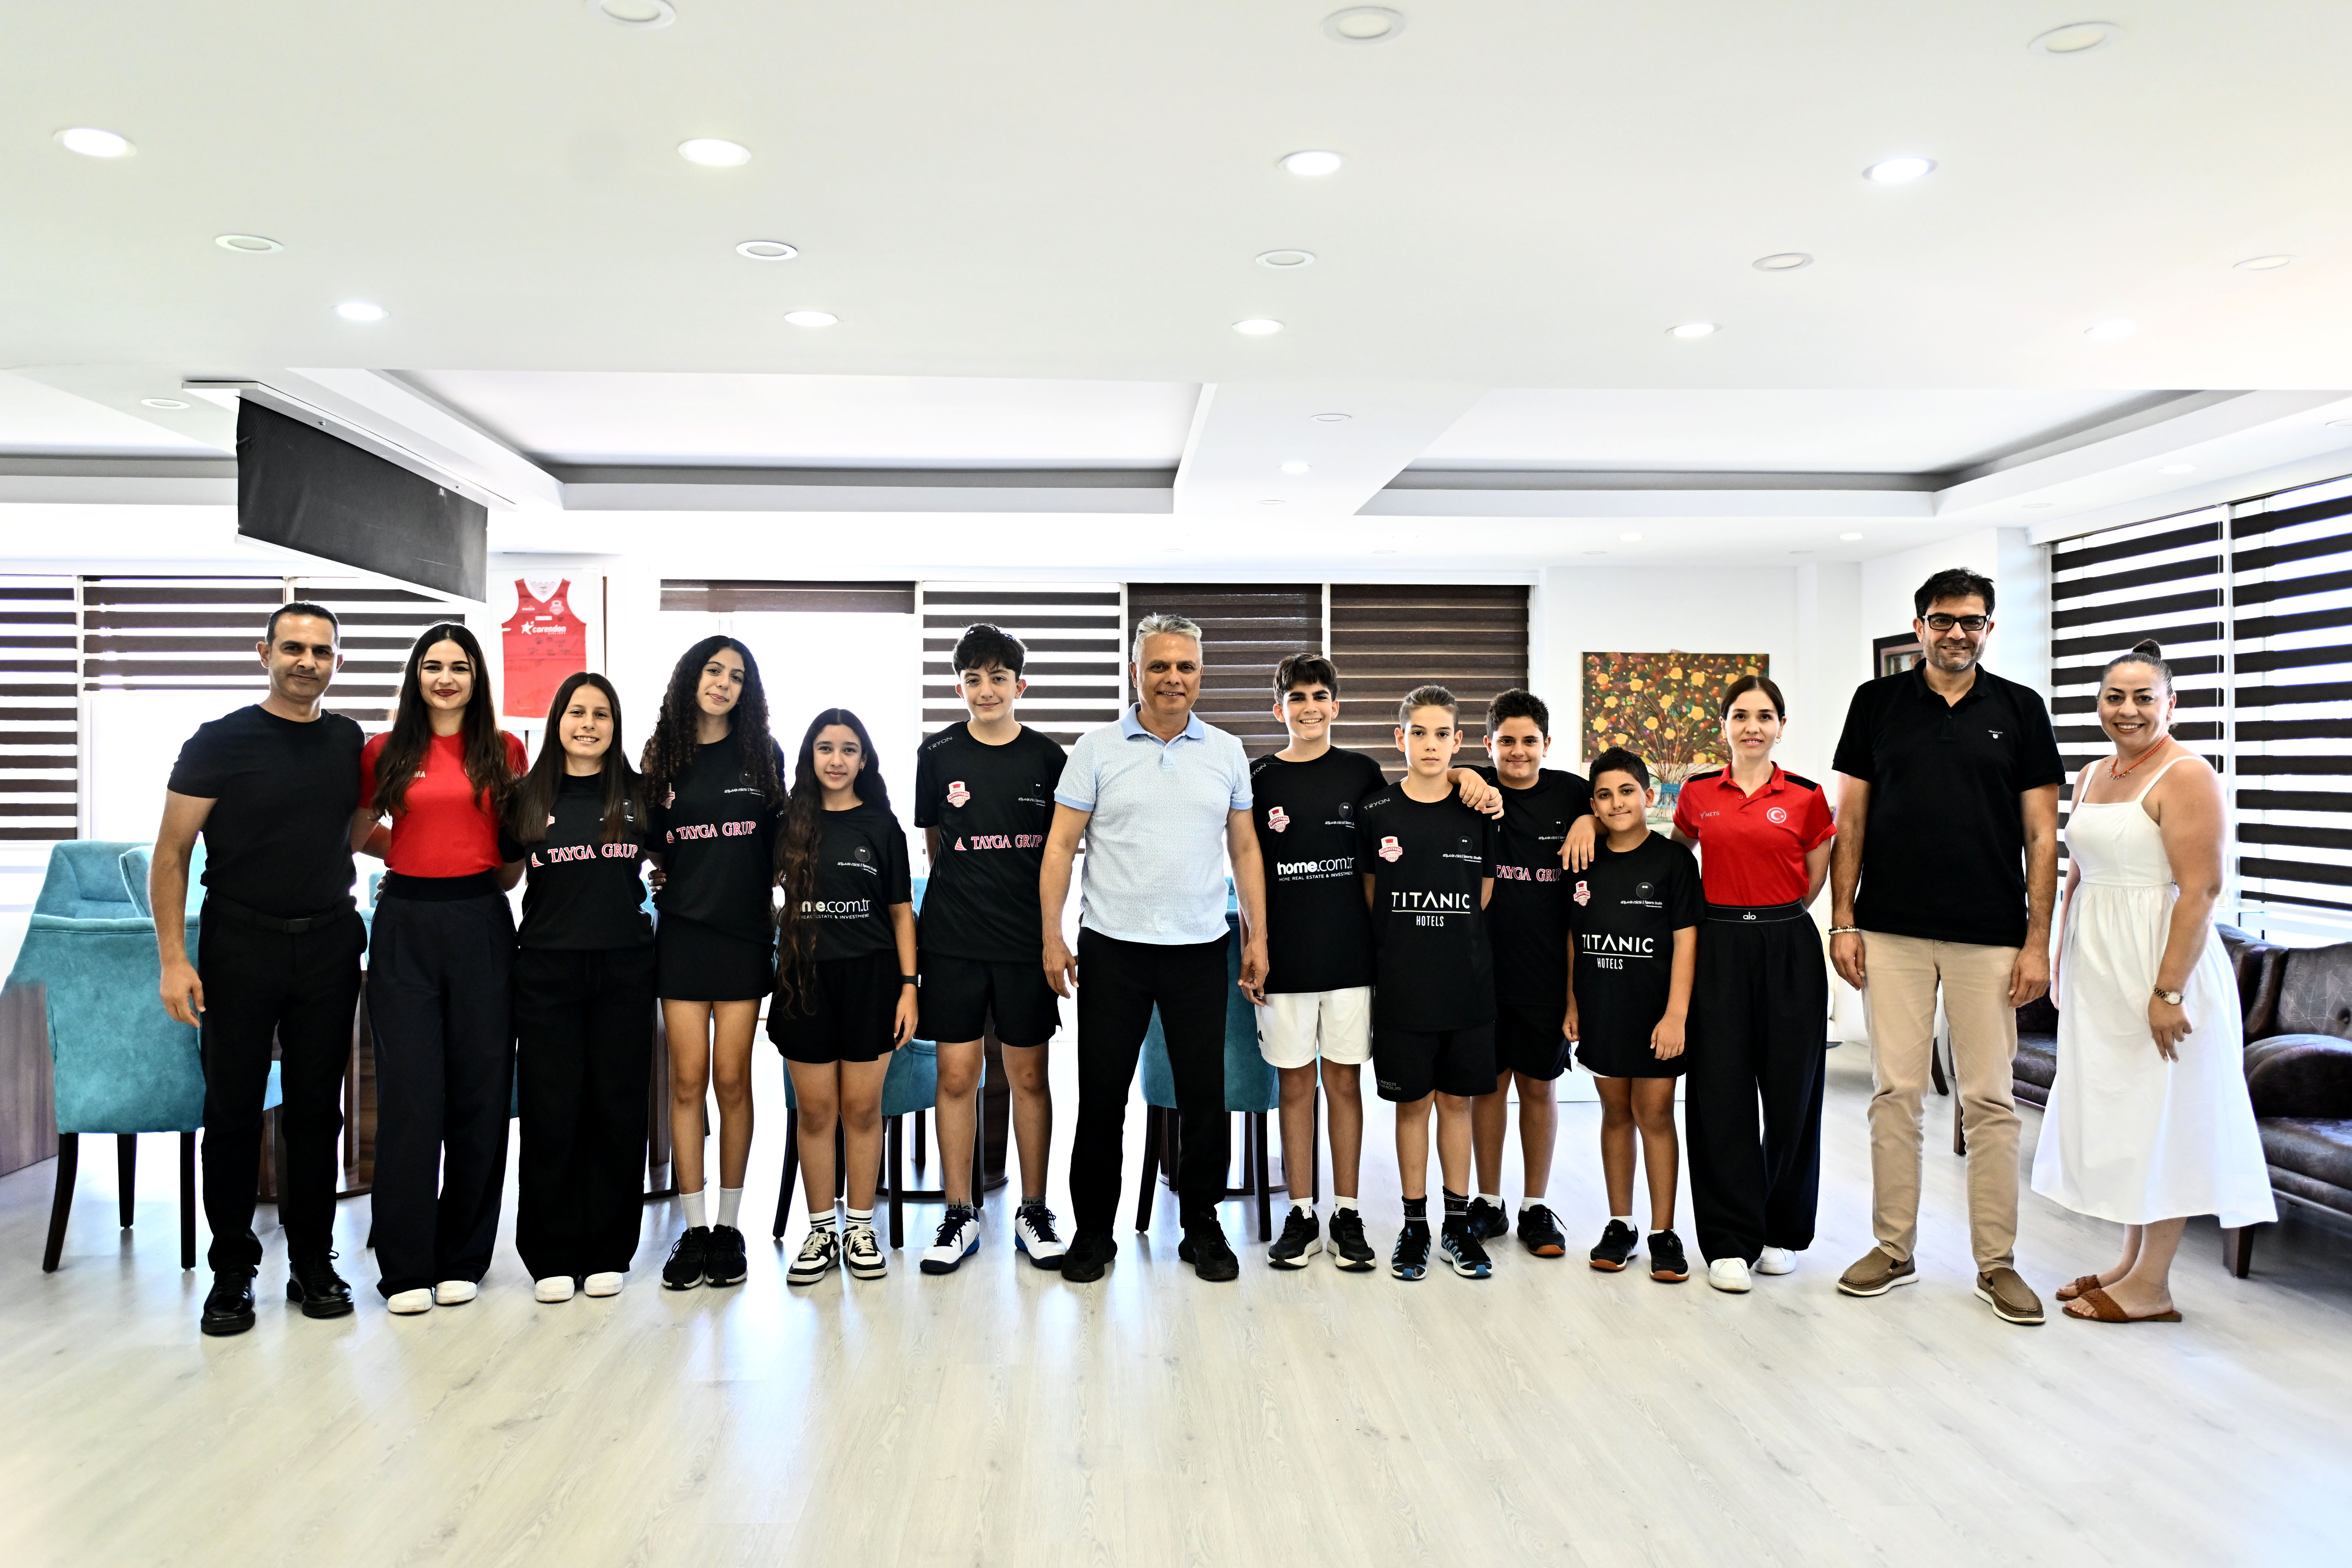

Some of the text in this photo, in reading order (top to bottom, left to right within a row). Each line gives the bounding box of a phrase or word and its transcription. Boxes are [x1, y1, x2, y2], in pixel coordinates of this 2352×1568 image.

[533, 625, 566, 633] corendon
[927, 736, 952, 750] TRYON
[1250, 763, 1266, 779] RYON
[1364, 798, 1390, 810] TRYON
[676, 821, 756, 839] TAYGA GRUP
[971, 835, 1042, 849] TAYGA GRUP
[547, 843, 638, 863] TAYGA GRUP
[1277, 856, 1354, 875] home.com.tr
[1496, 865, 1561, 882] TAYGA GRUP
[1392, 891, 1470, 909] TITANIC
[1416, 916, 1444, 927] HOTELS
[1743, 912, 1756, 921] alo
[1582, 933, 1654, 953] TITANIC
[1597, 958, 1623, 970] HOTELS
